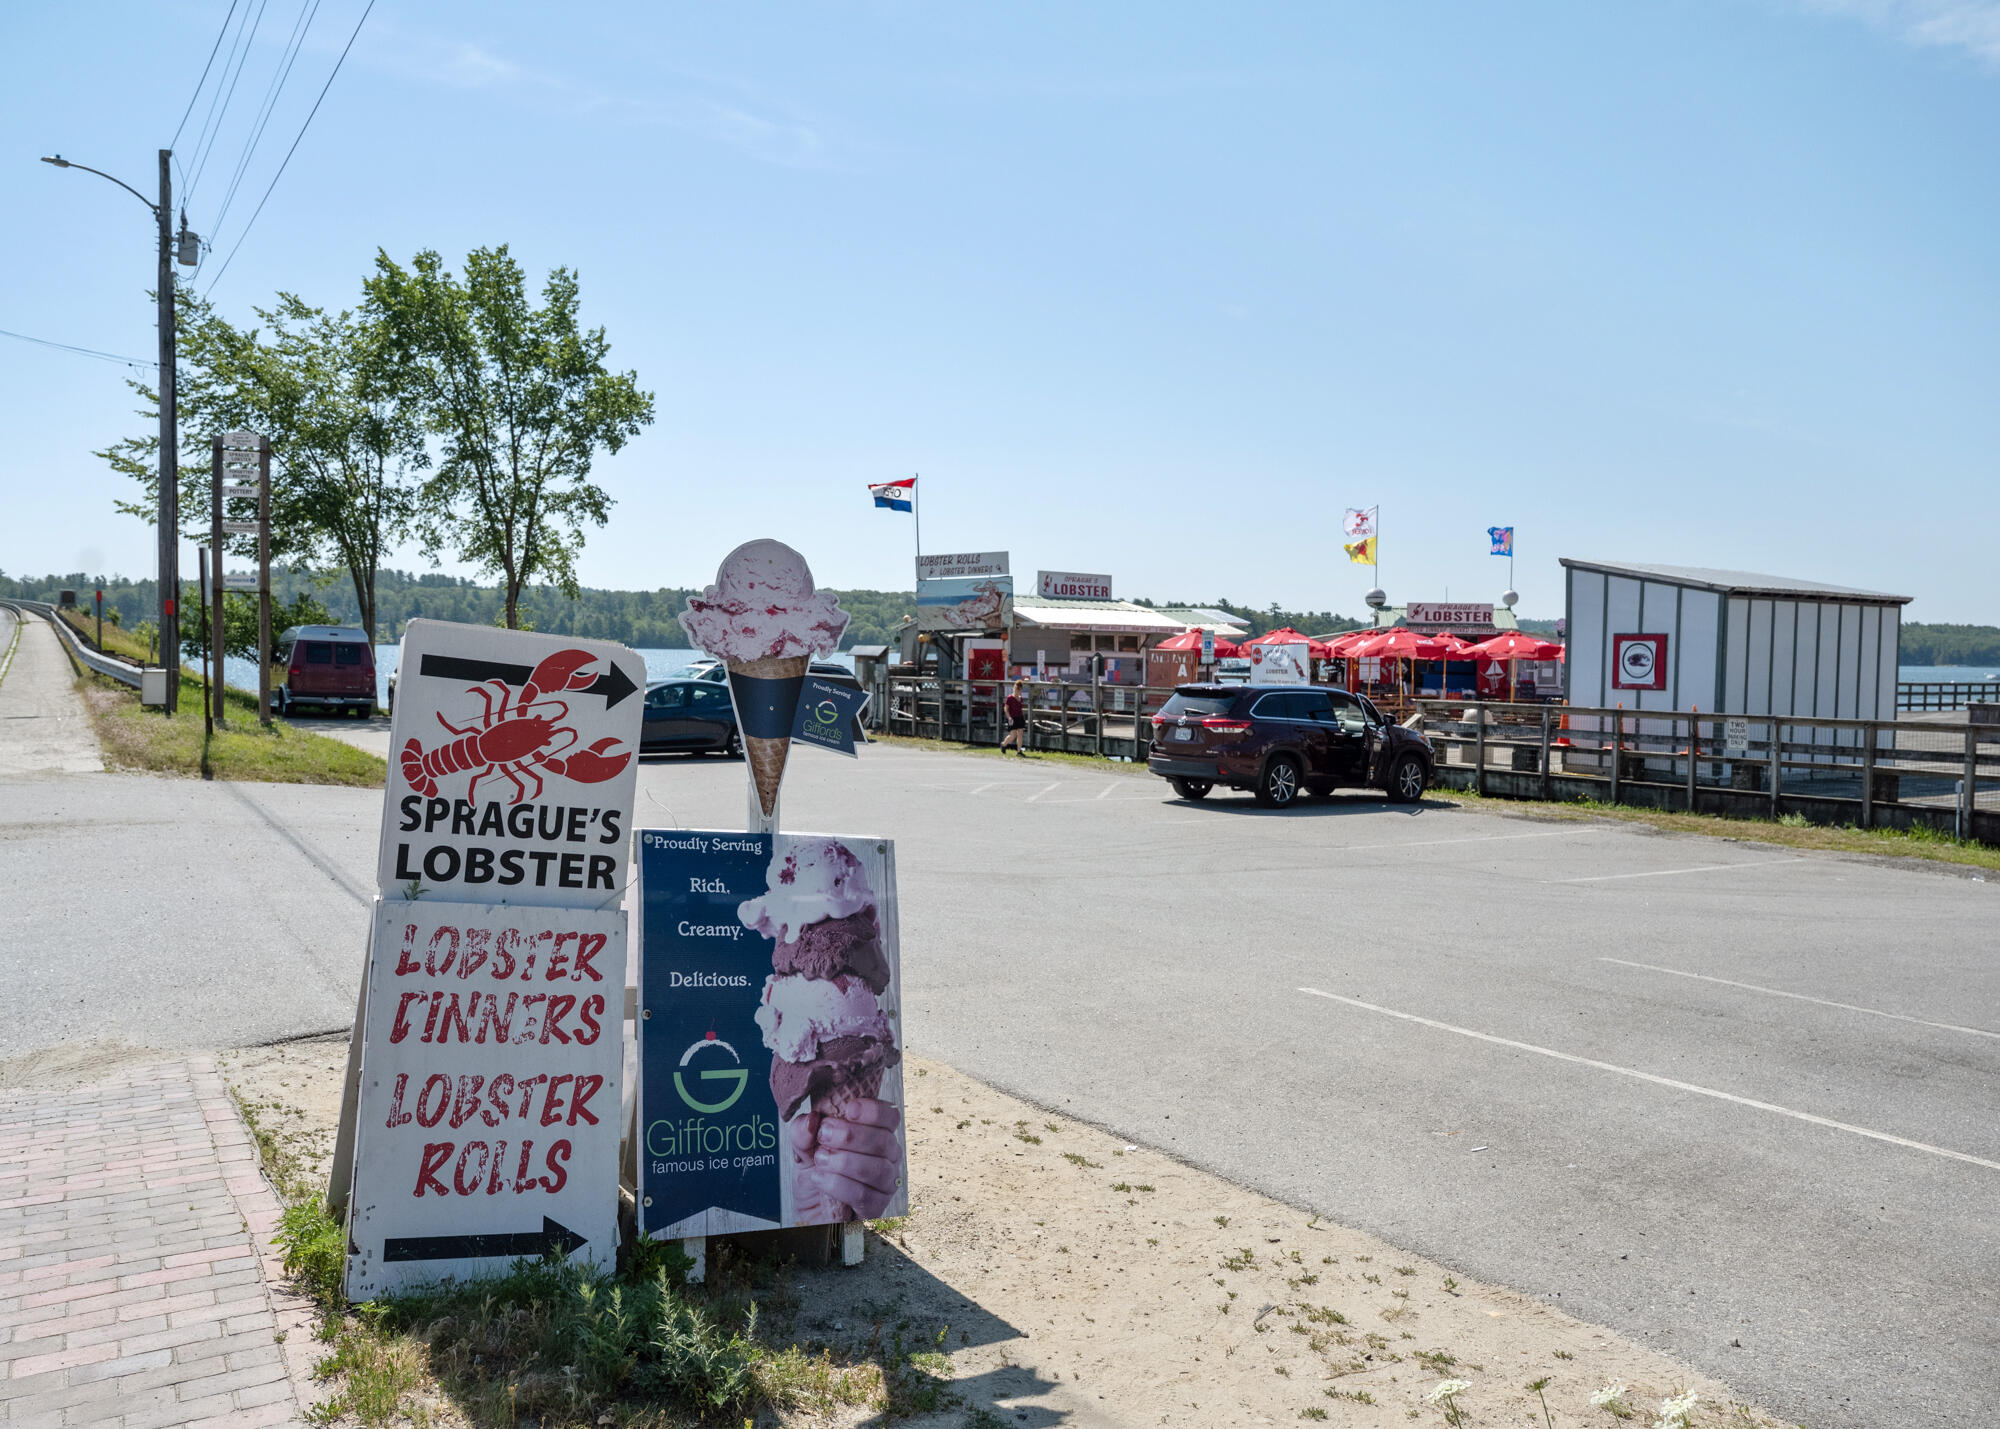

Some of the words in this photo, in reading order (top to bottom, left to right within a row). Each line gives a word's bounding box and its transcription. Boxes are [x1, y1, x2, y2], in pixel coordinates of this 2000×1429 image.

[920, 556, 953, 566] LOBSTER
[957, 554, 981, 564] ROLLS
[940, 567, 965, 576] LOBSTER
[1054, 584, 1108, 597] LOBSTER
[1424, 611, 1492, 622] LOBSTER
[812, 682, 832, 694] Proudly
[833, 688, 852, 699] Serving
[400, 795, 621, 844] SPRAGUE'S
[654, 836, 708, 852] Proudly
[712, 838, 762, 855] Serving
[396, 844, 616, 890] LOBSTER
[690, 878, 730, 895] Rich.
[678, 921, 744, 940] Creamy.
[395, 924, 608, 982] LOBSTER
[669, 972, 752, 988] Delicious.
[385, 1072, 604, 1129] LOBSTER
[646, 1114, 776, 1157] Gifford's
[413, 1138, 571, 1198] ROLLS
[652, 1159, 704, 1174] famous
[709, 1156, 729, 1170] ice
[733, 1154, 774, 1167] cream
